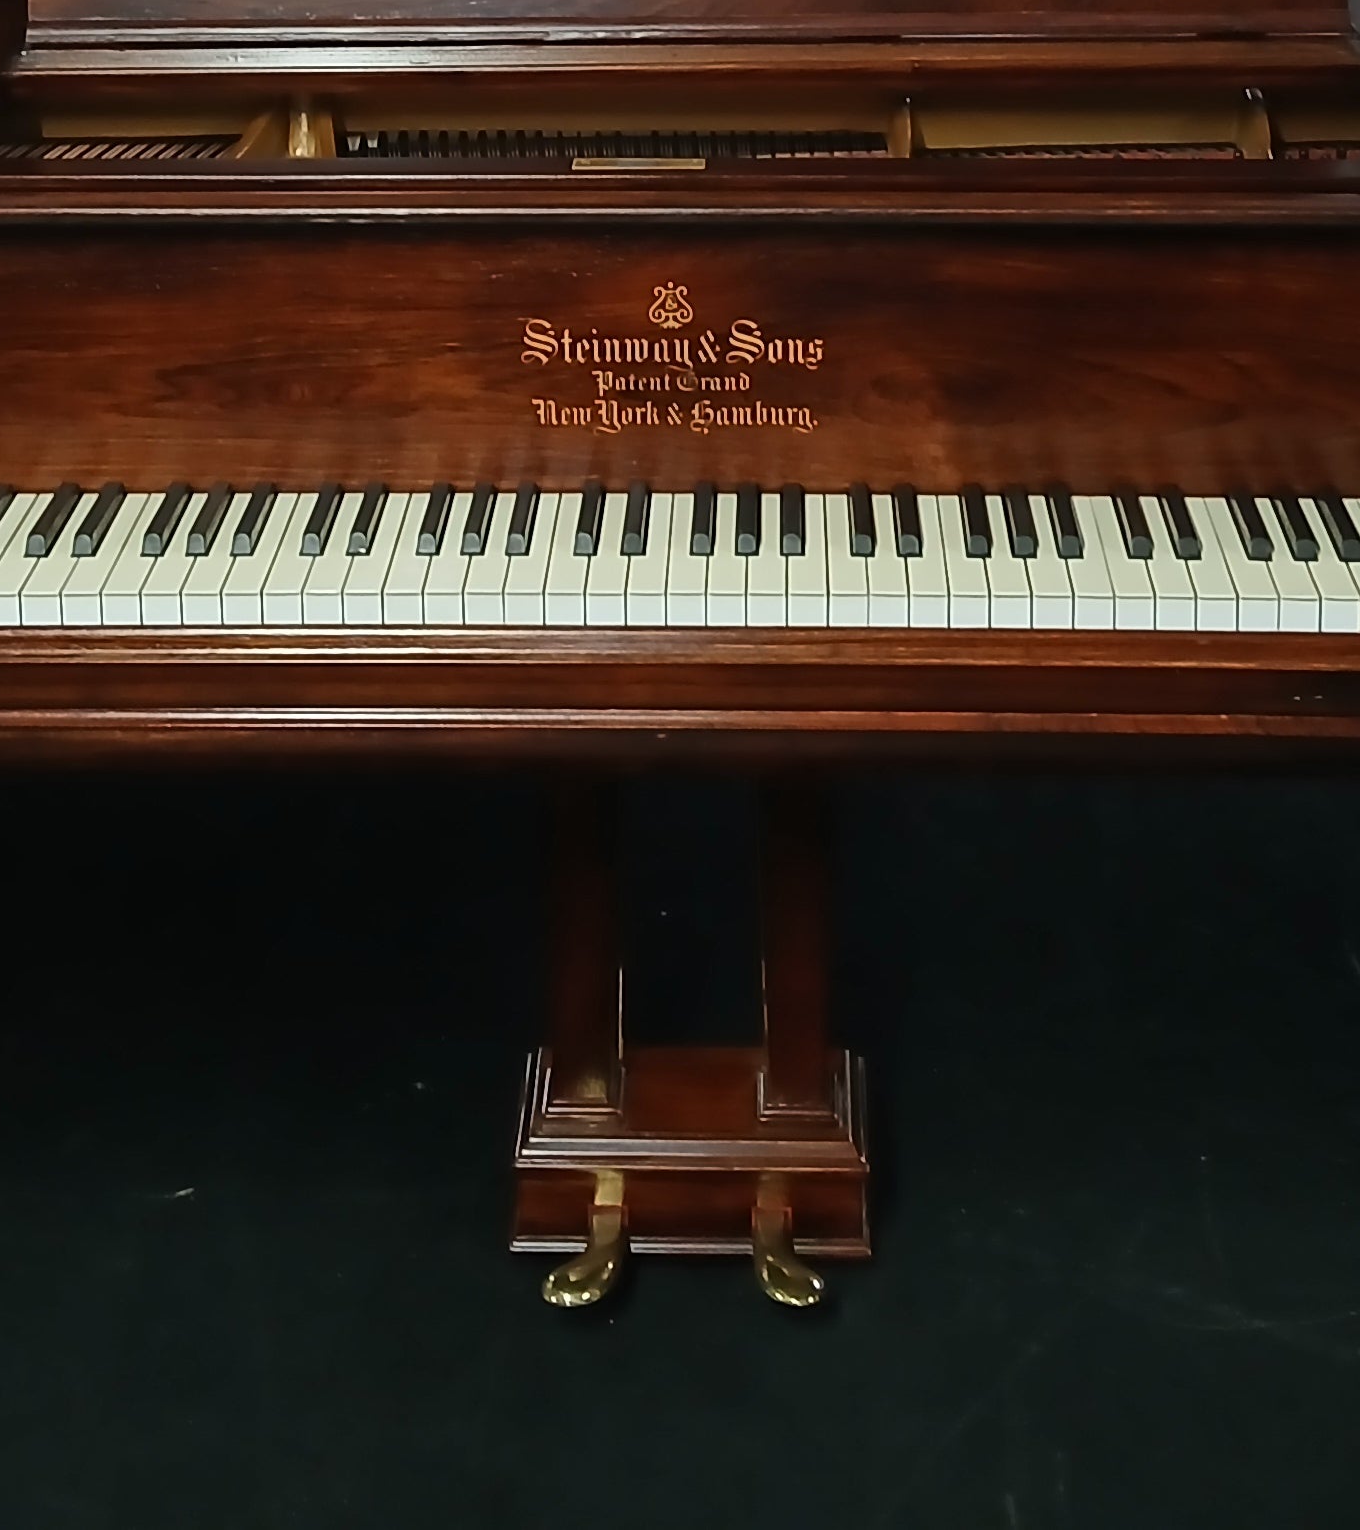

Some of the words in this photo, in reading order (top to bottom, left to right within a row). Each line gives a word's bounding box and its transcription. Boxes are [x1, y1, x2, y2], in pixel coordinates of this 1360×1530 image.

[520, 319, 693, 371] Steinway
[697, 329, 721, 364] &
[725, 319, 824, 370] Sons
[591, 370, 670, 396] Patent
[676, 370, 751, 392] Grand
[531, 398, 591, 426] New
[593, 399, 660, 434] York
[666, 402, 684, 426] &
